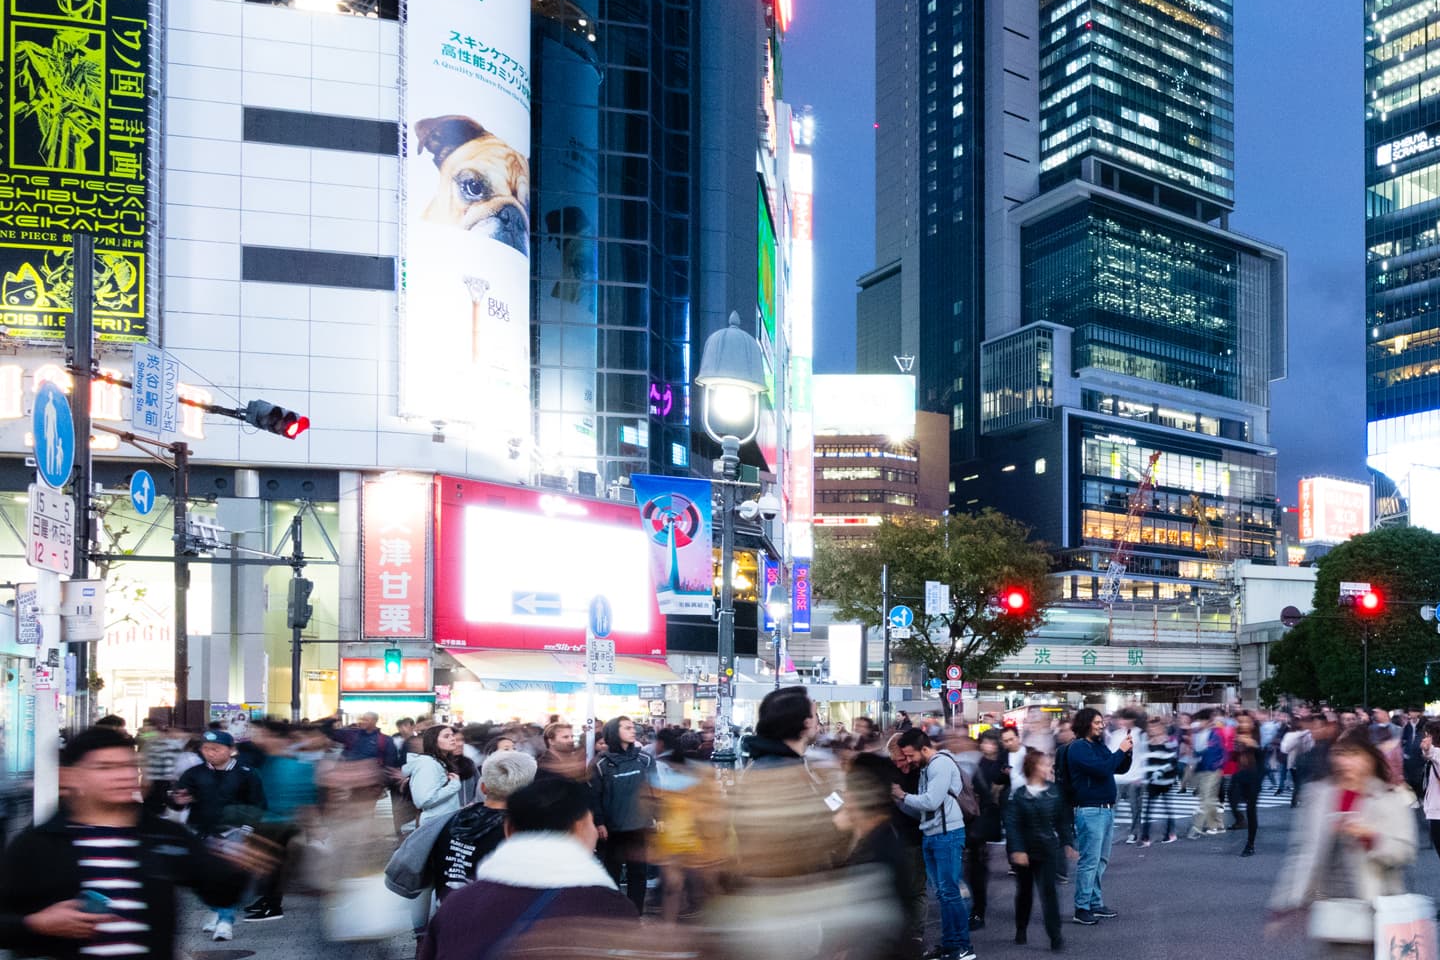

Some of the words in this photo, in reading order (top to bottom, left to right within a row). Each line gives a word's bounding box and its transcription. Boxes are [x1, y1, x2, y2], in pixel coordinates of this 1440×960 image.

[1392, 131, 1428, 152] SHIBUYA
[1392, 137, 1435, 161] SCRAMBLE
[0, 186, 144, 209] SHIBUYA
[61, 178, 145, 195] PIECE
[21, 230, 57, 241] PIECE
[136, 361, 145, 395] Shibuya
[145, 354, 161, 427] 渋谷駅前
[378, 508, 412, 633] 津甘栗
[1034, 647, 1144, 666] 渋谷駅
